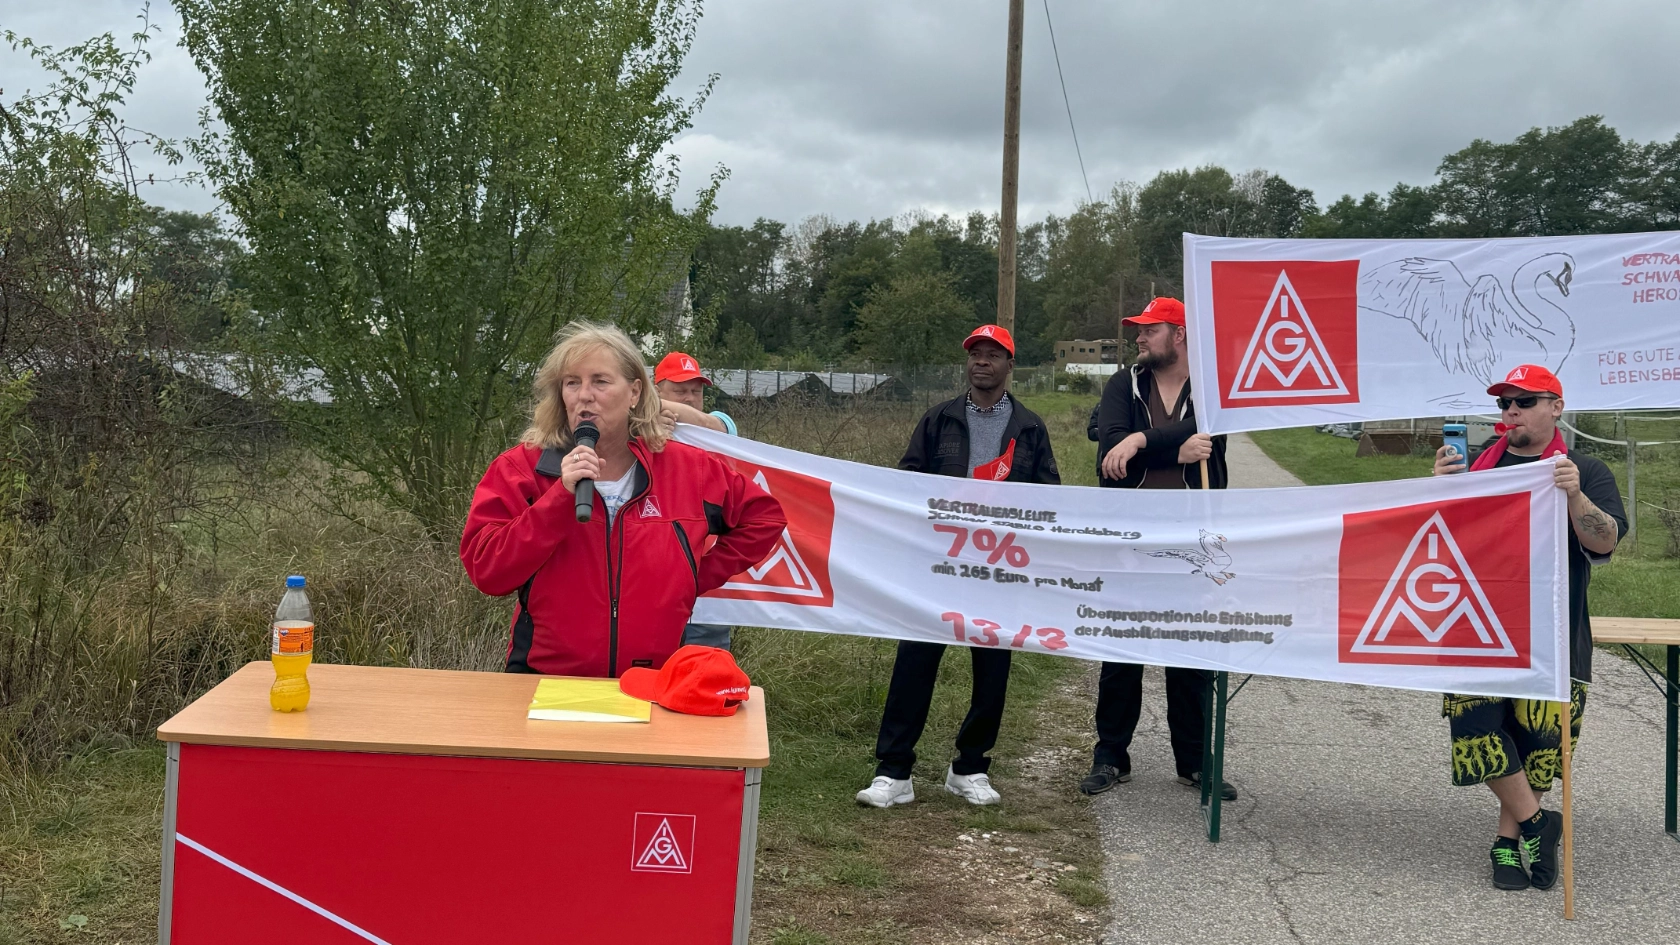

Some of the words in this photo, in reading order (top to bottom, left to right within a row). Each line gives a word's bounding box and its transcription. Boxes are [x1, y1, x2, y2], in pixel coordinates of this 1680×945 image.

[1621, 269, 1680, 286] SCHWA
[1633, 287, 1680, 304] HERO
[1598, 350, 1628, 367] FÜR
[1633, 347, 1675, 363] GUTE
[927, 497, 1057, 523] VERTRAUENSLEUTE
[1050, 525, 1142, 540] Heroldsberg
[933, 523, 1031, 569] 7%
[930, 561, 957, 577] min.
[959, 564, 991, 581] 265
[993, 567, 1030, 584] Euro
[1034, 577, 1058, 588] pro
[1060, 576, 1104, 592] Monat
[1076, 603, 1218, 624] Überproportionale
[1218, 610, 1293, 627] Erhöhung
[1074, 625, 1101, 637] der
